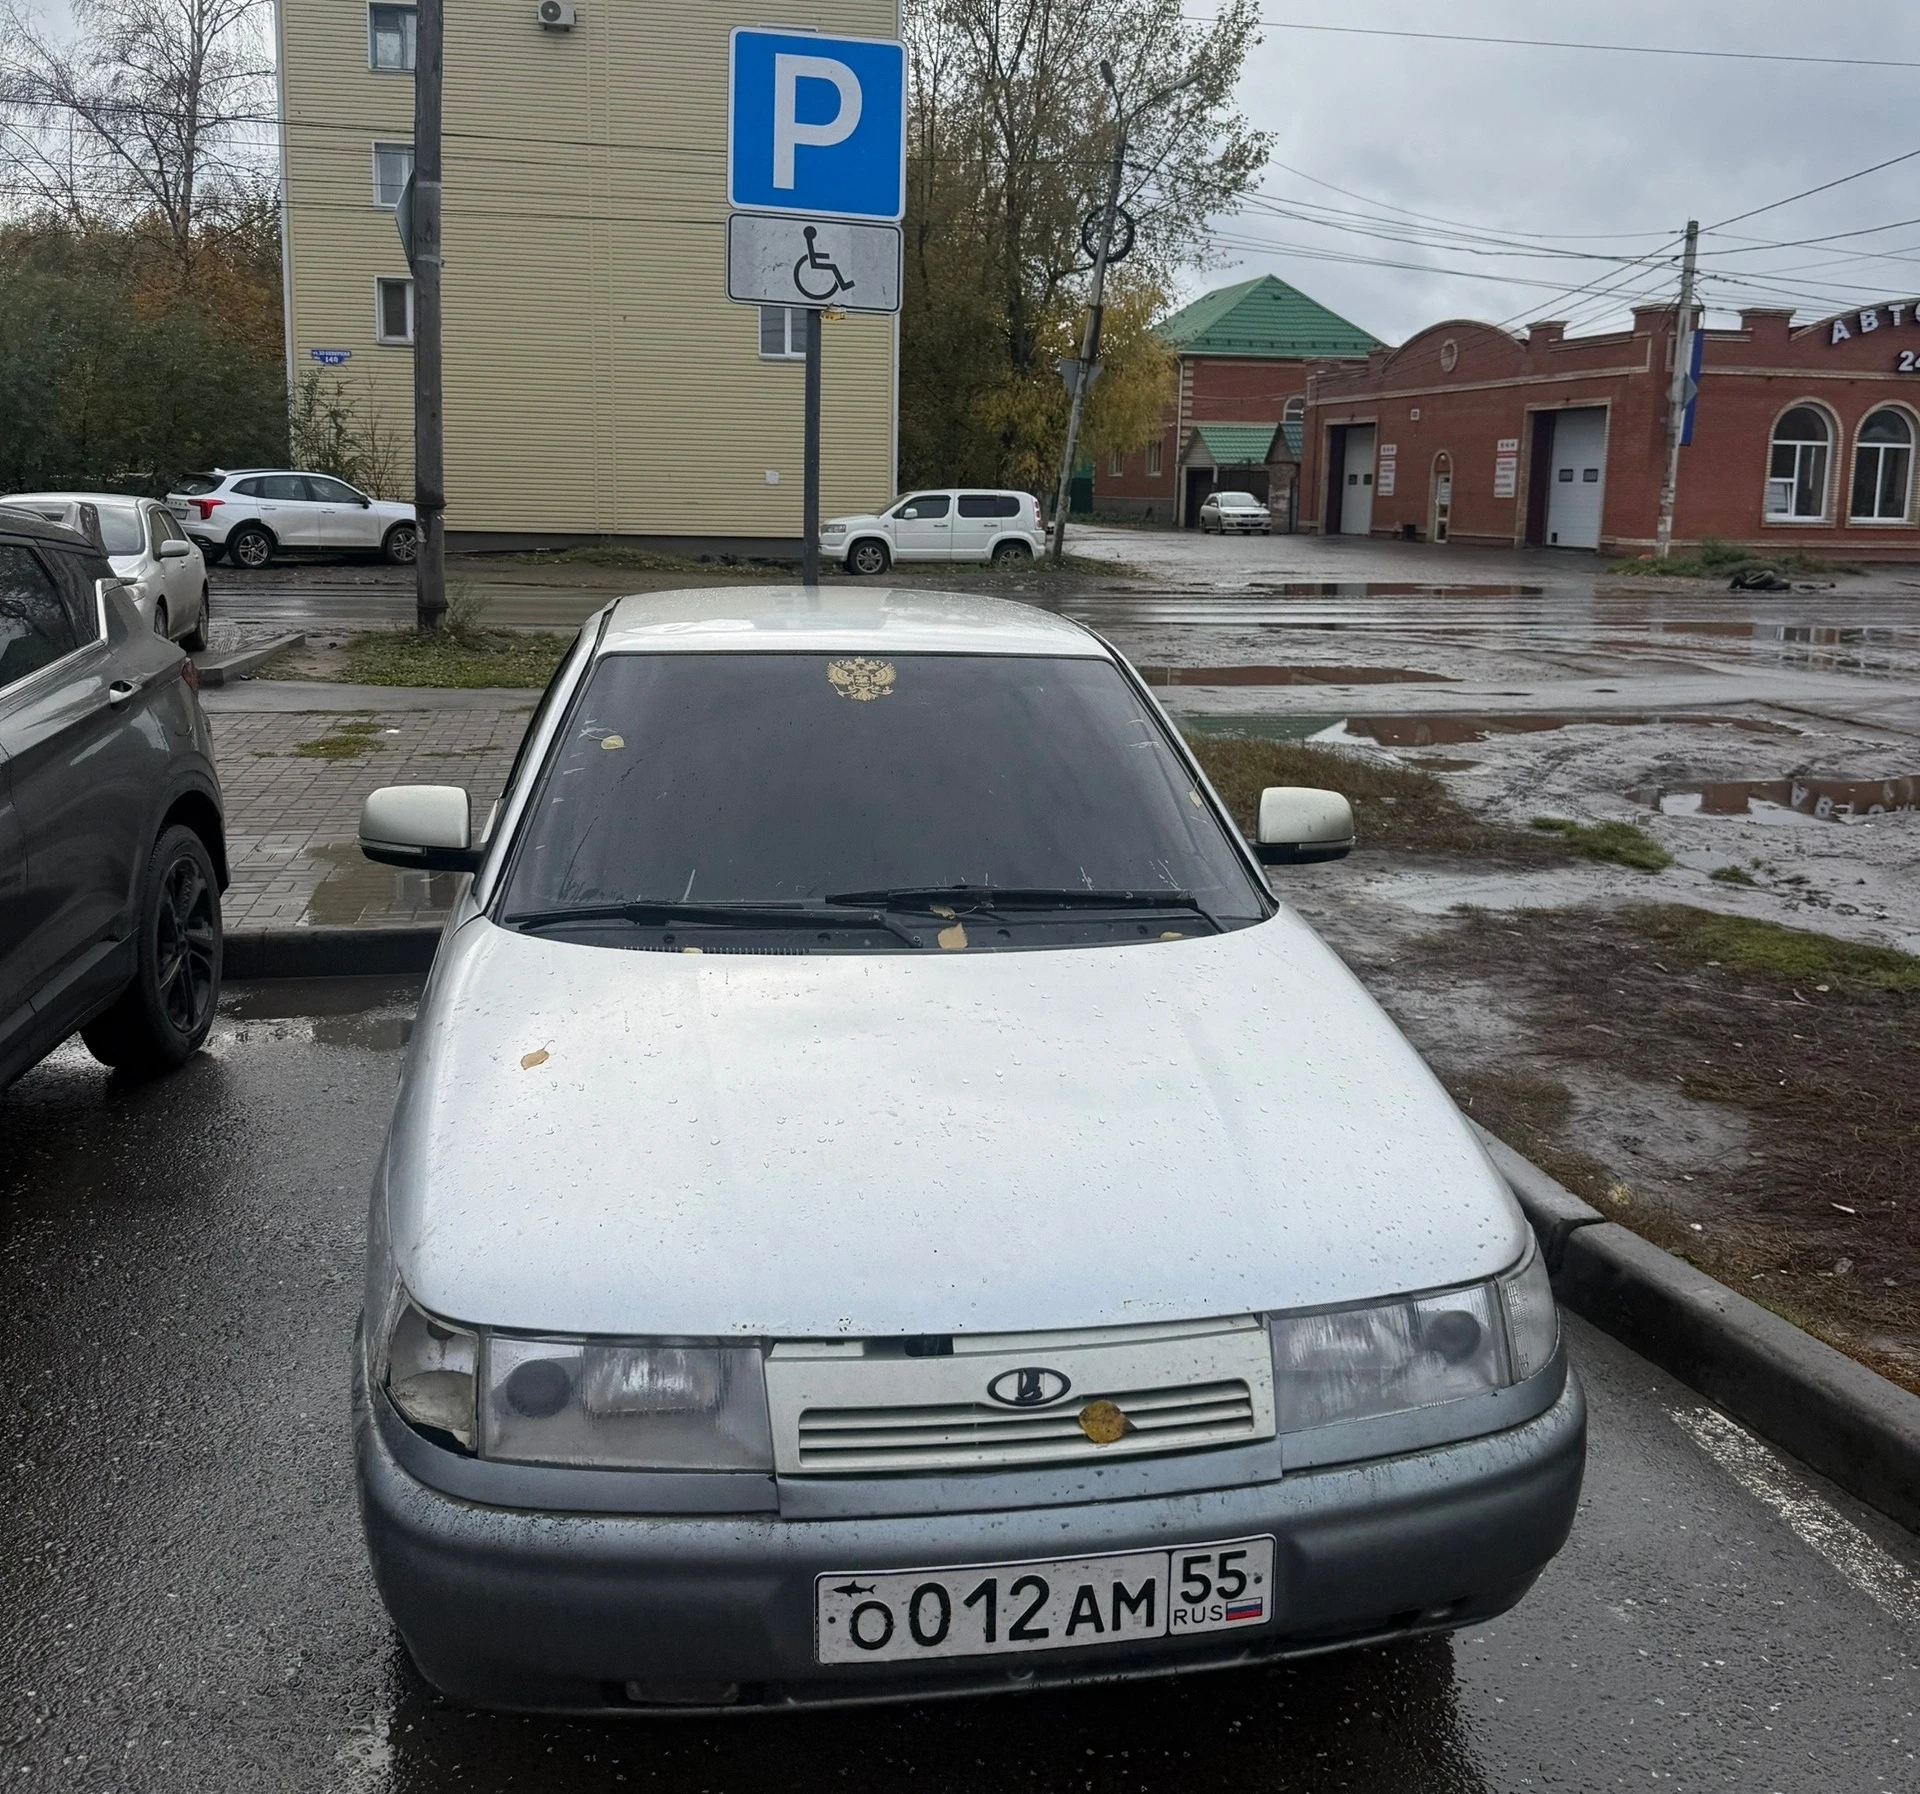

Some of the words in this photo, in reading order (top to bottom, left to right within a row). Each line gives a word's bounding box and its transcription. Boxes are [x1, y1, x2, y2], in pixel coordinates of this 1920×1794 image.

[773, 53, 863, 190] P
[1831, 302, 1920, 345] АВТ
[1898, 350, 1920, 371] 2
[1180, 1549, 1247, 1604] 55
[1174, 1605, 1223, 1626] RUS
